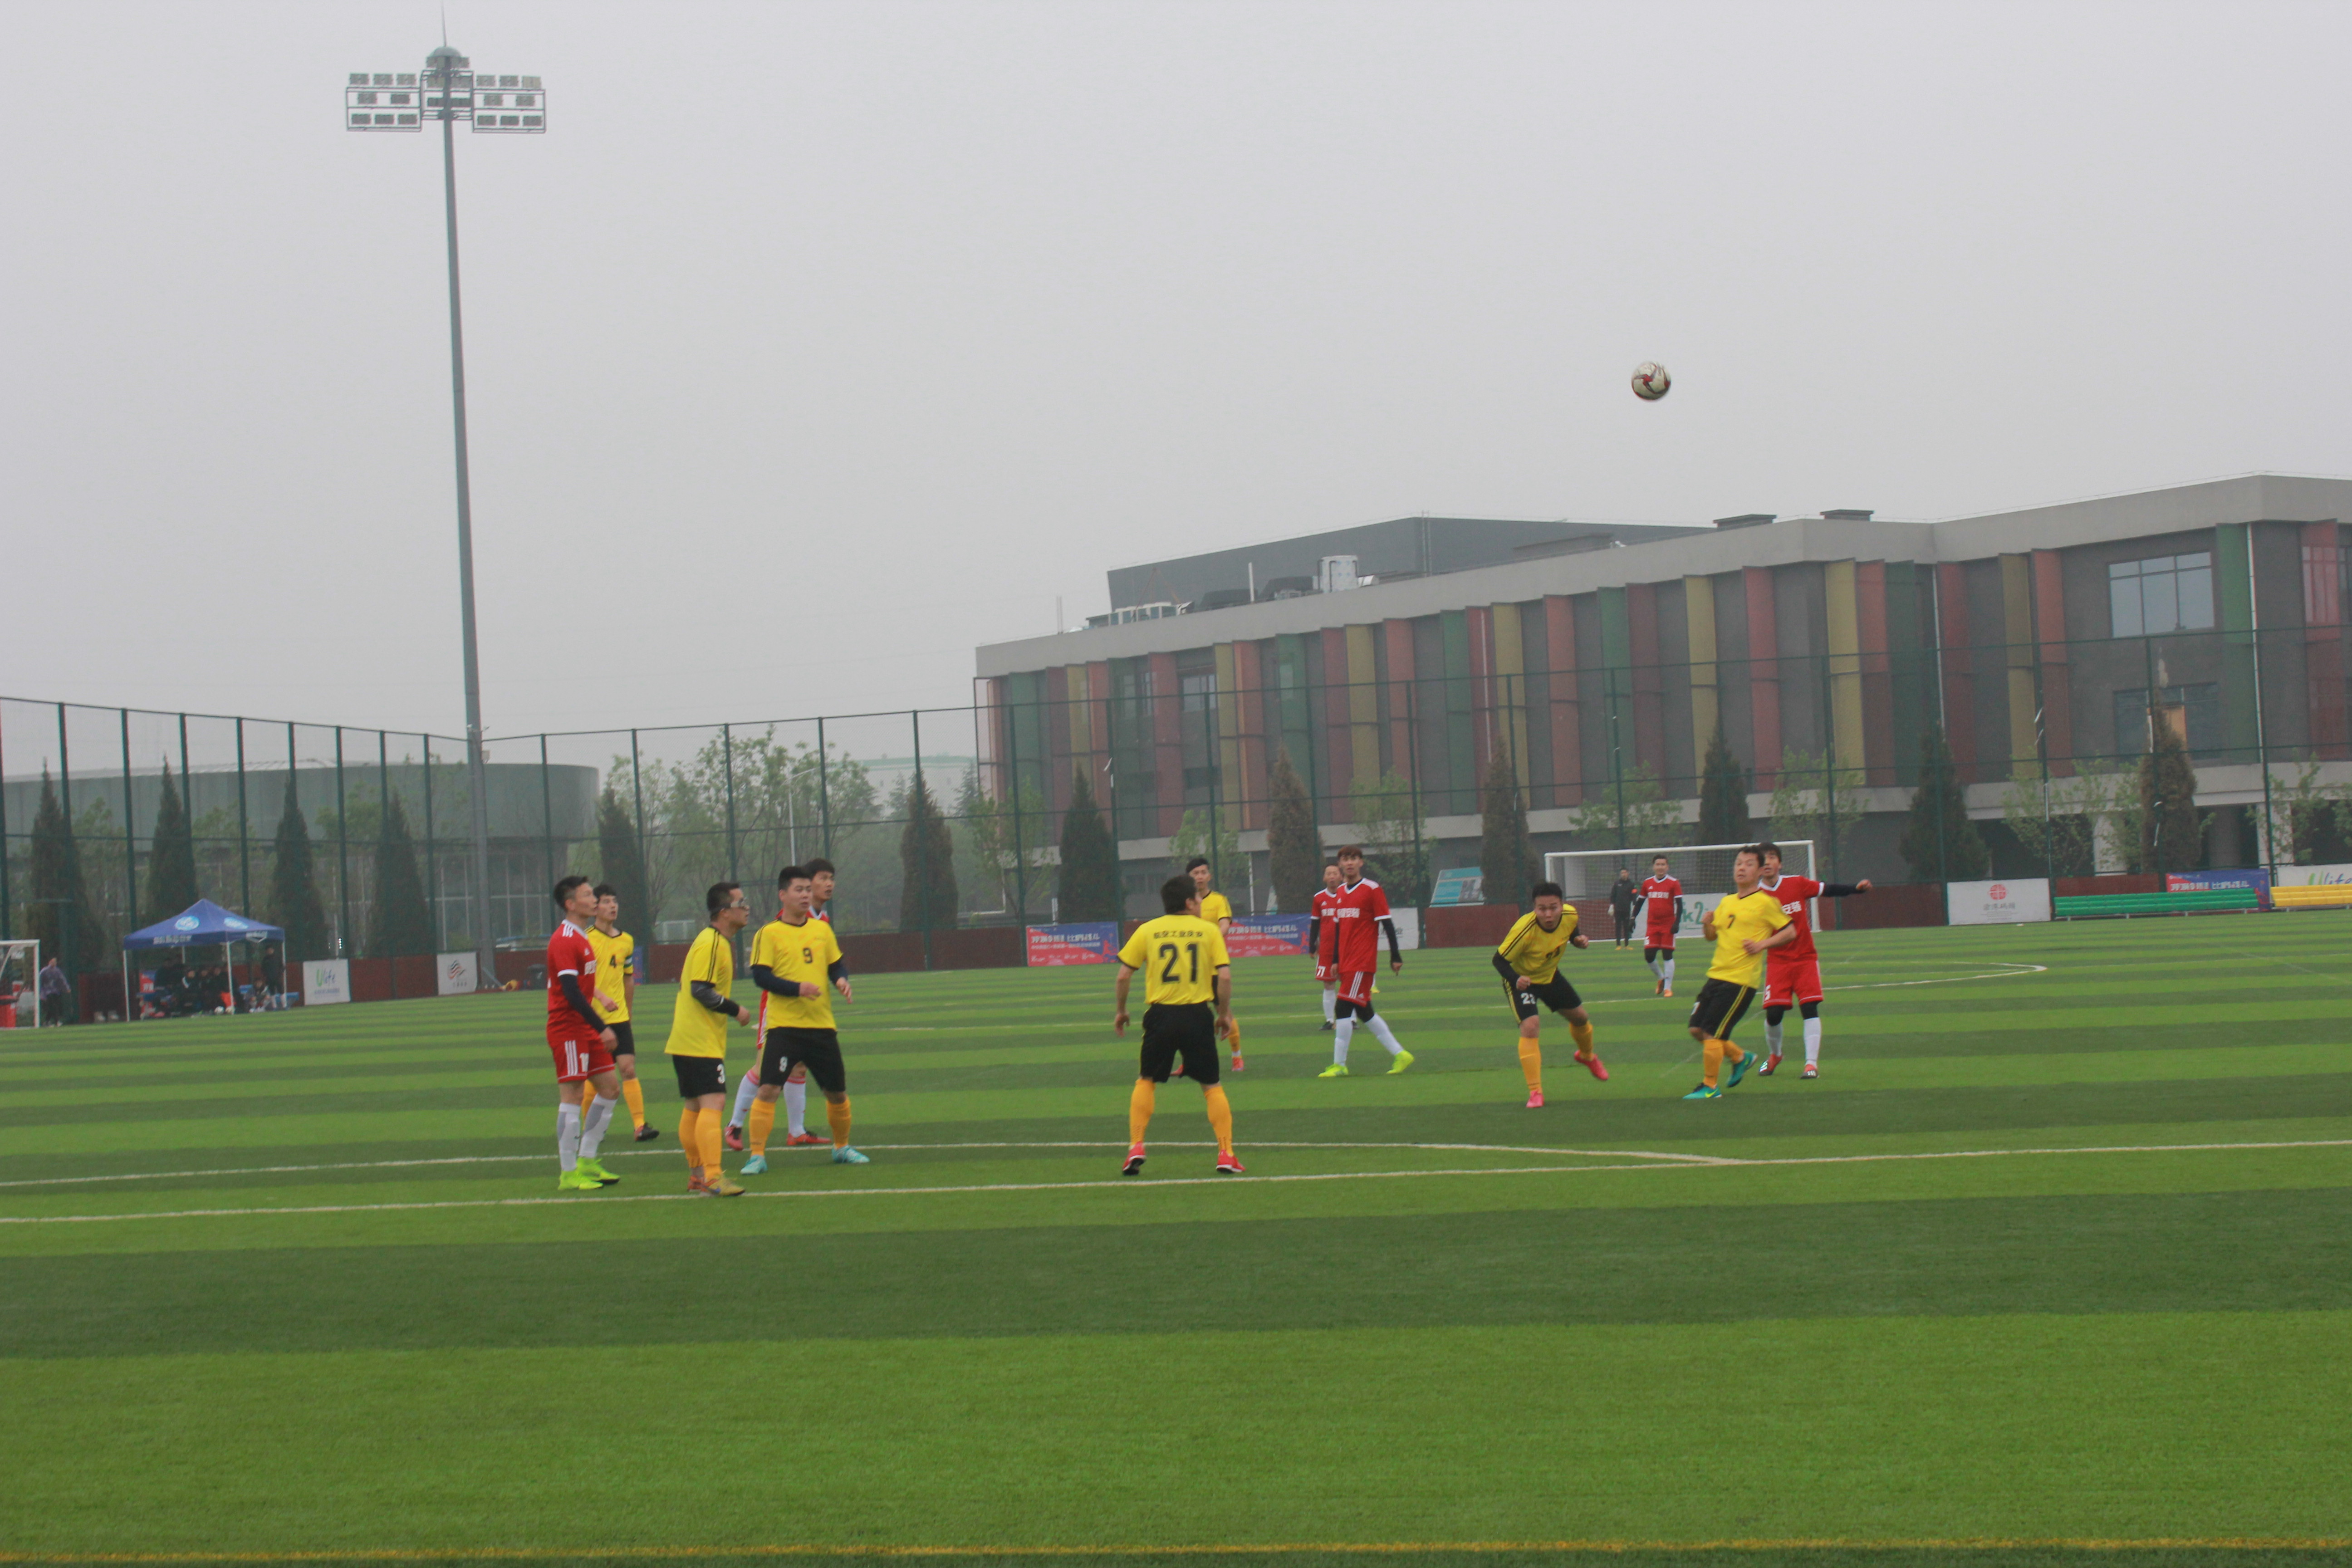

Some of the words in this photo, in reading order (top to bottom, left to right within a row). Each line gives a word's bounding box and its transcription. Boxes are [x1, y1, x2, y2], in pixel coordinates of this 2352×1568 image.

[1727, 914, 1736, 929] 7
[609, 954, 617, 969] 4
[803, 947, 813, 963] 9
[1159, 942, 1198, 984] 21
[1317, 966, 1326, 977] 77
